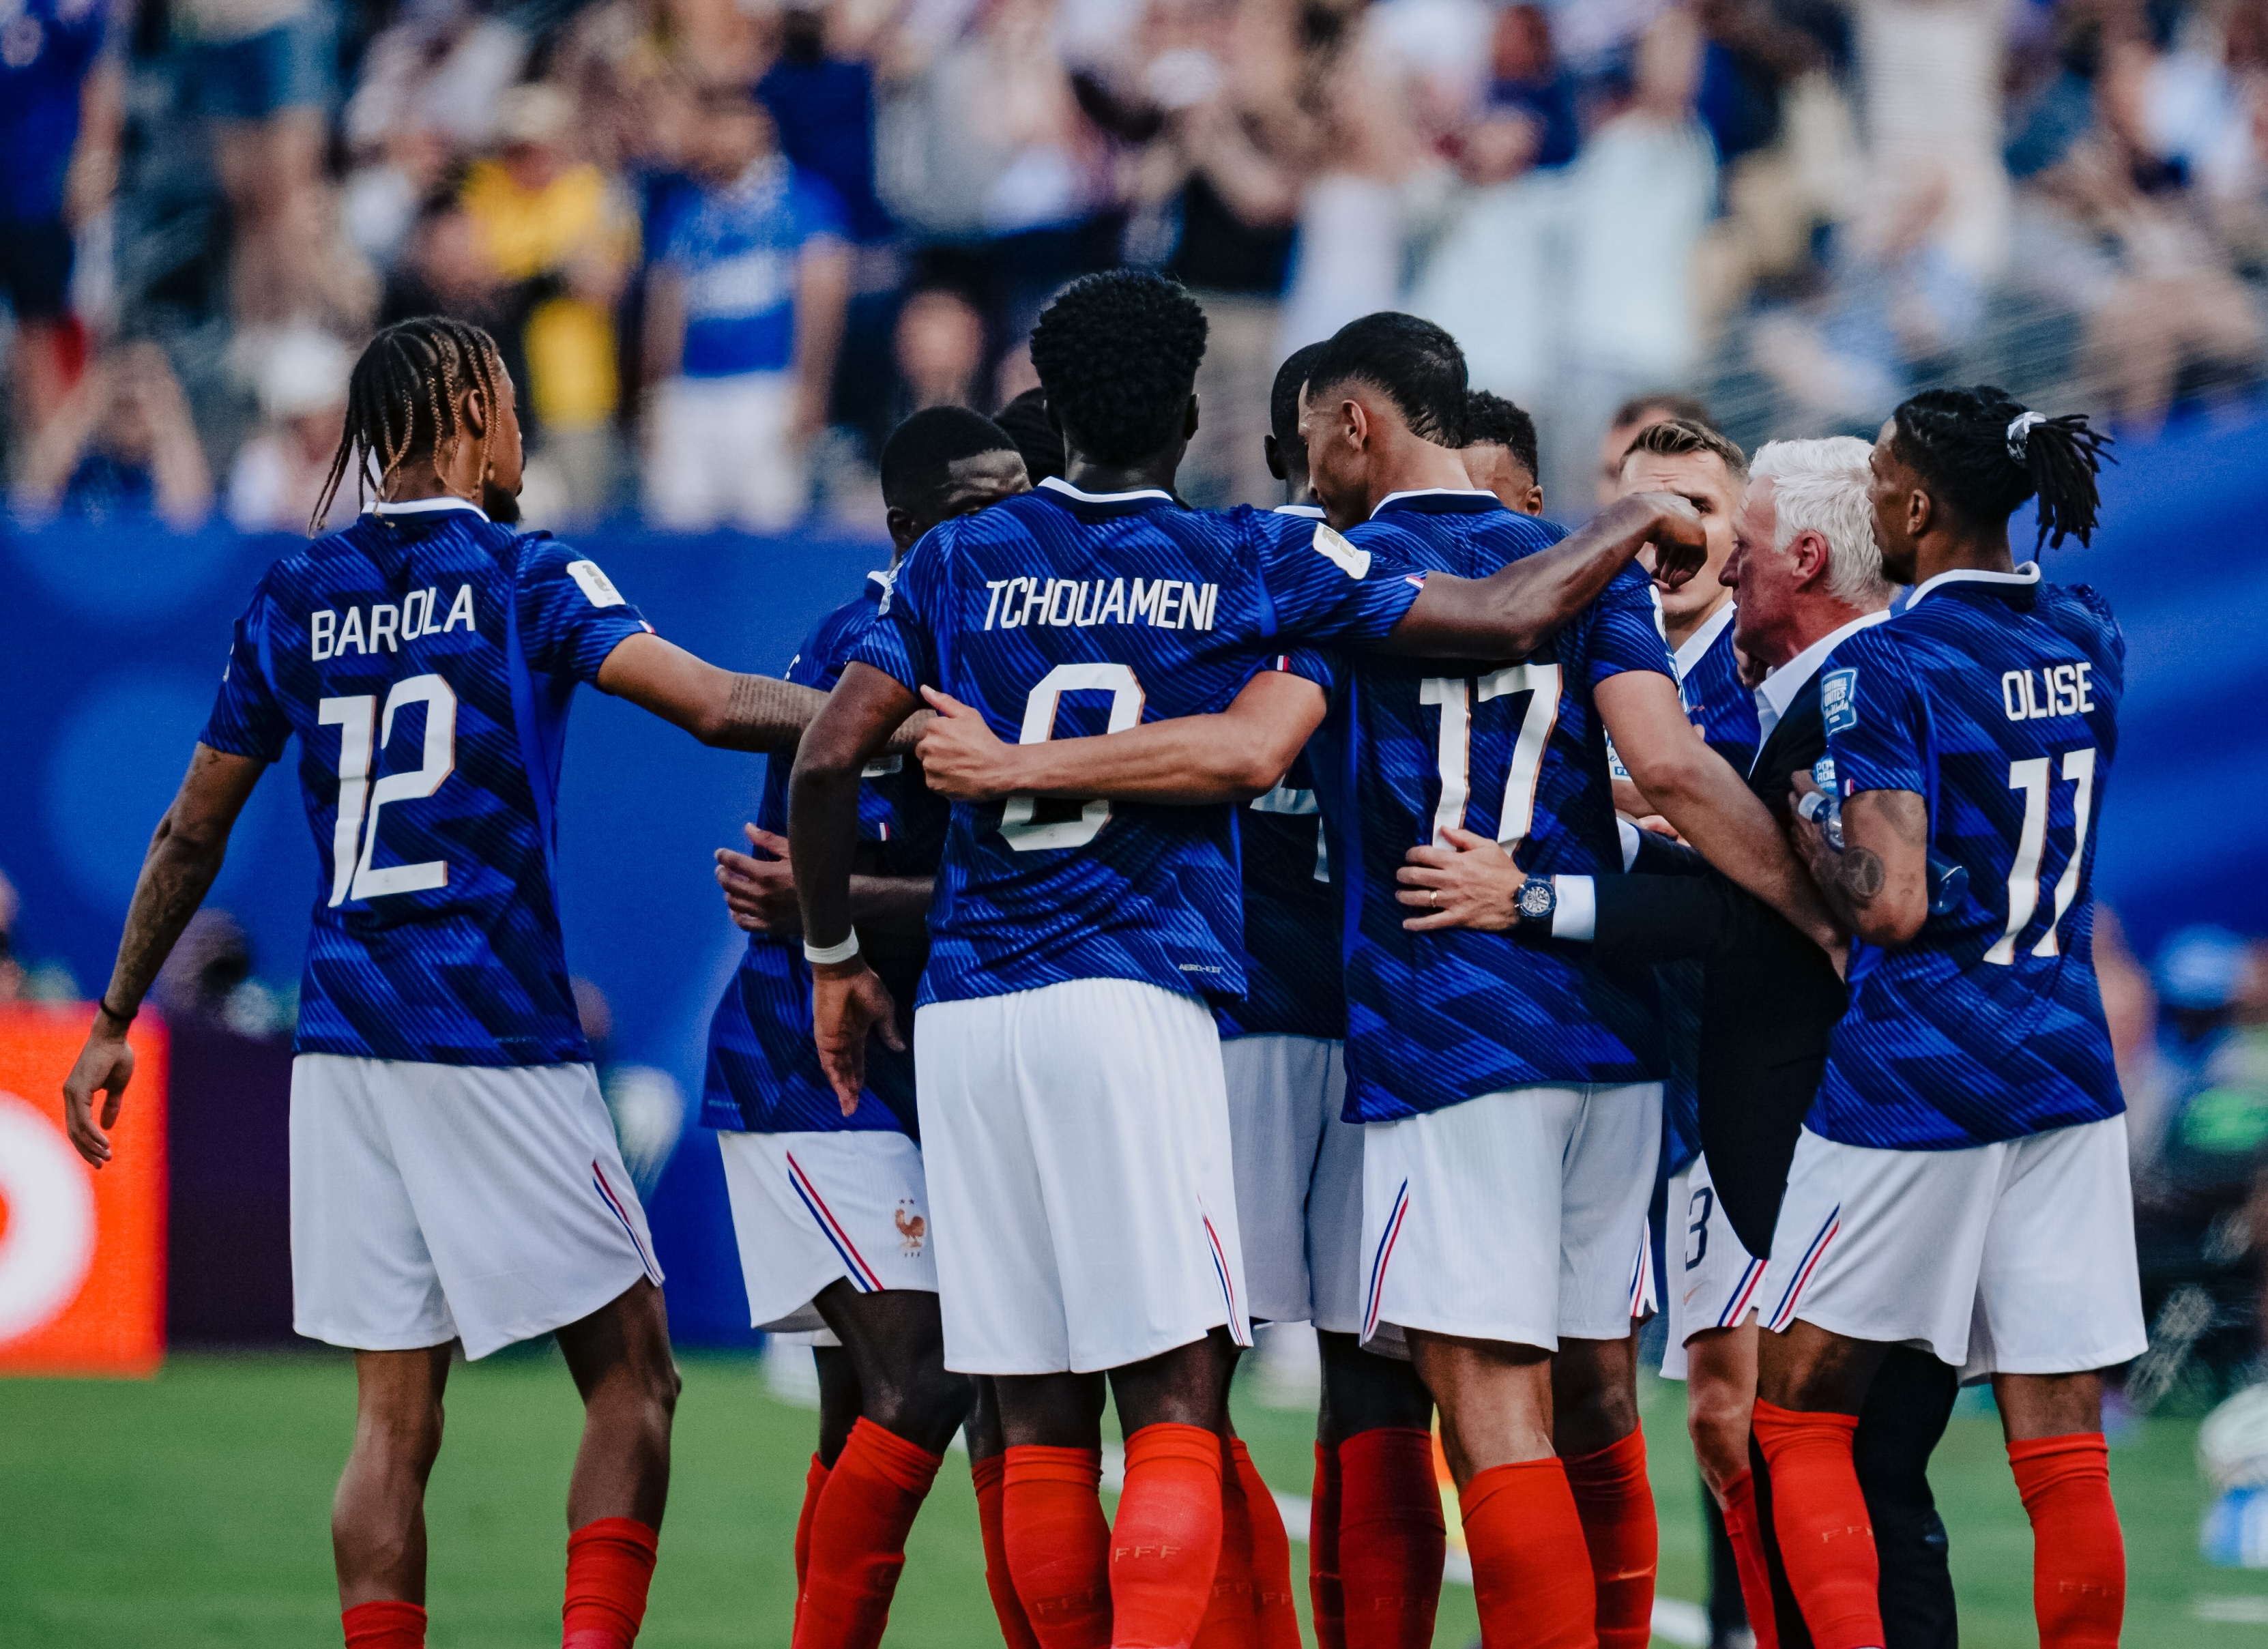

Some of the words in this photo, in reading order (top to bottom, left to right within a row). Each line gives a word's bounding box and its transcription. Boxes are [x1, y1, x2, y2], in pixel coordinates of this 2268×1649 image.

[984, 577, 1217, 631] TCHOUAMENI
[2001, 662, 2095, 721] OLISE
[318, 673, 458, 907] 12
[1419, 662, 1563, 857] 17
[1982, 748, 2097, 965] 11
[1685, 1186, 1713, 1272] 3
[1115, 1545, 1182, 1563] FFF
